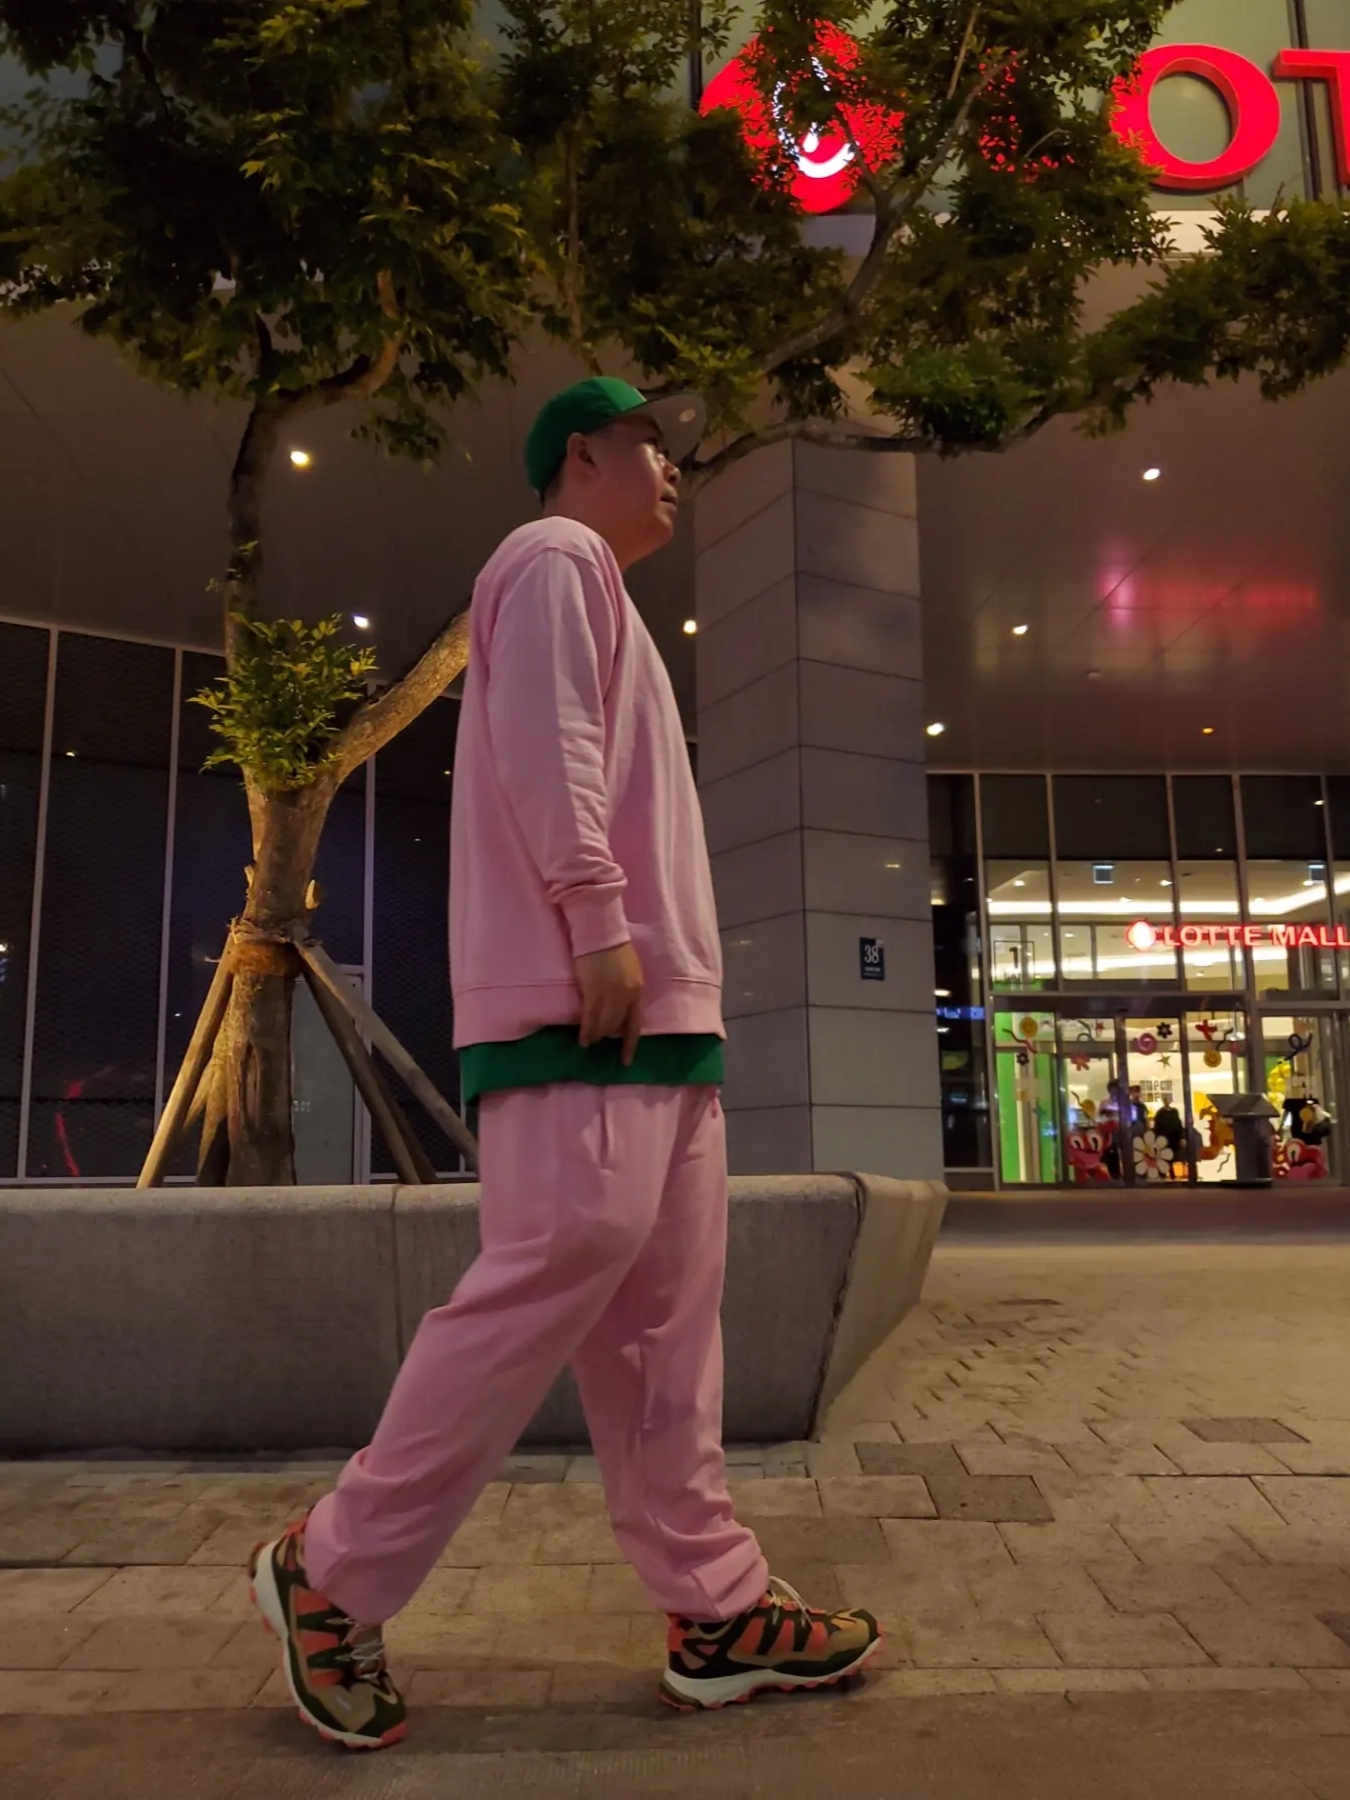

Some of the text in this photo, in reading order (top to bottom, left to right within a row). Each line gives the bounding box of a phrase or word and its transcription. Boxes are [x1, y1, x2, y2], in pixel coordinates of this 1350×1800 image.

[1163, 925, 1350, 947] LOTTE MALL
[864, 944, 879, 964] 38
[1009, 947, 1018, 969] 1
